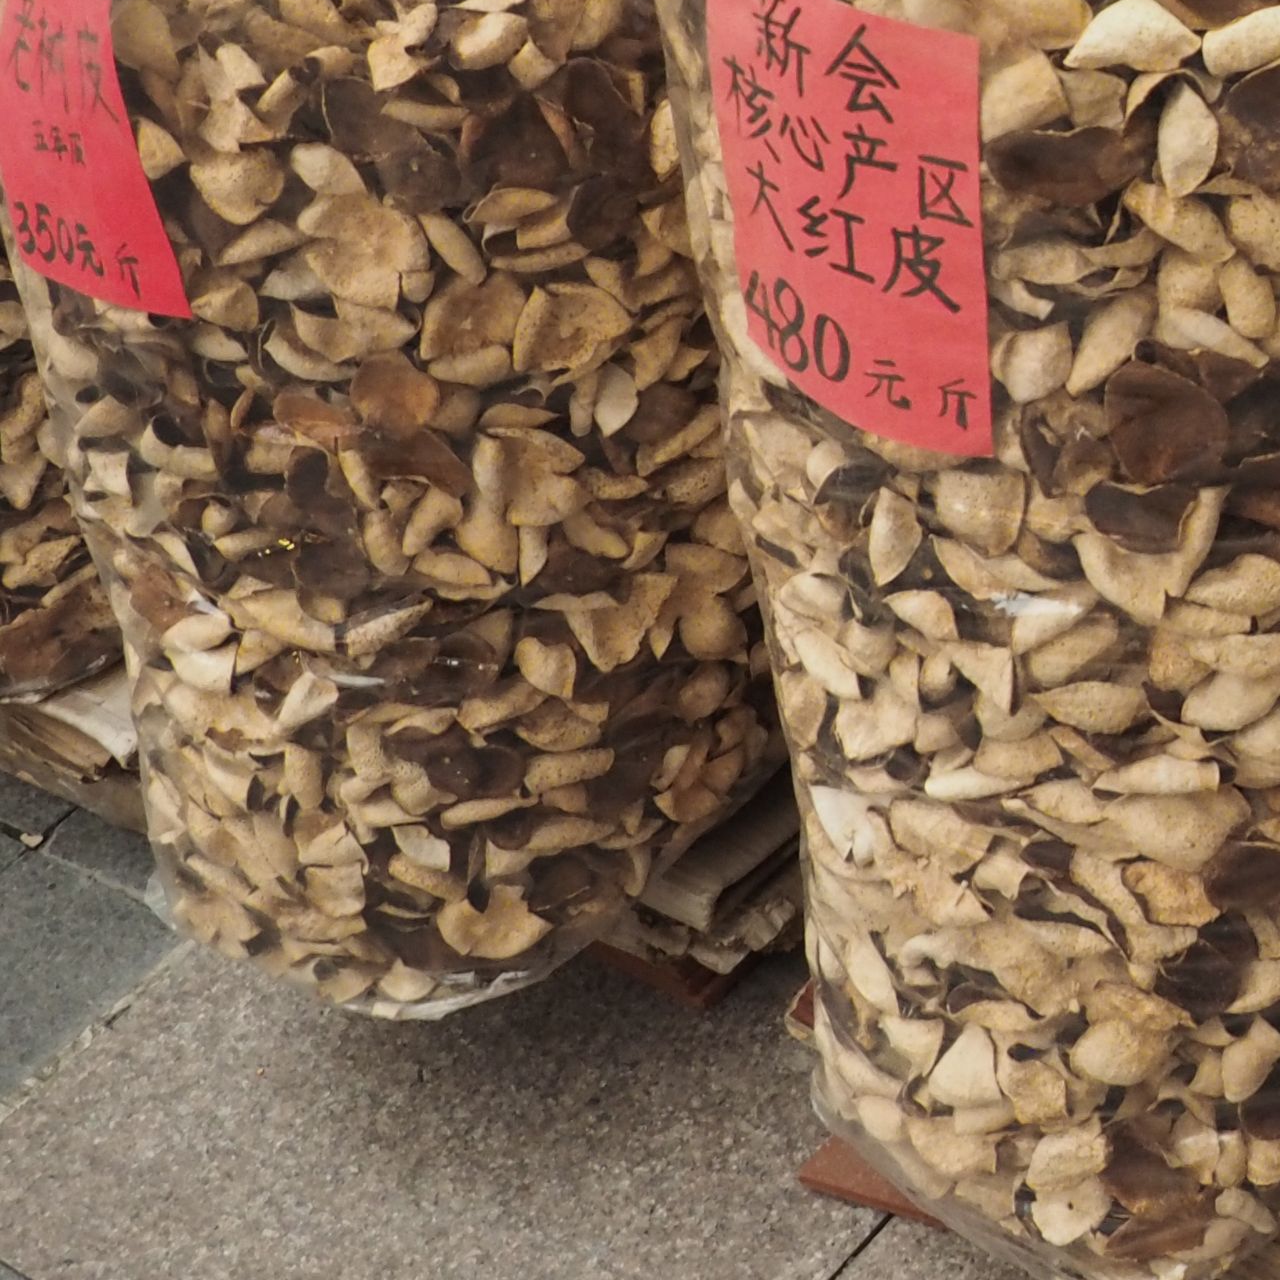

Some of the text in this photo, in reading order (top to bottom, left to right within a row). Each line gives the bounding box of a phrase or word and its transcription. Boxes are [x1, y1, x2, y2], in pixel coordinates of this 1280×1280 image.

[722, 53, 975, 229] 核心产区
[745, 158, 961, 314] 大红皮
